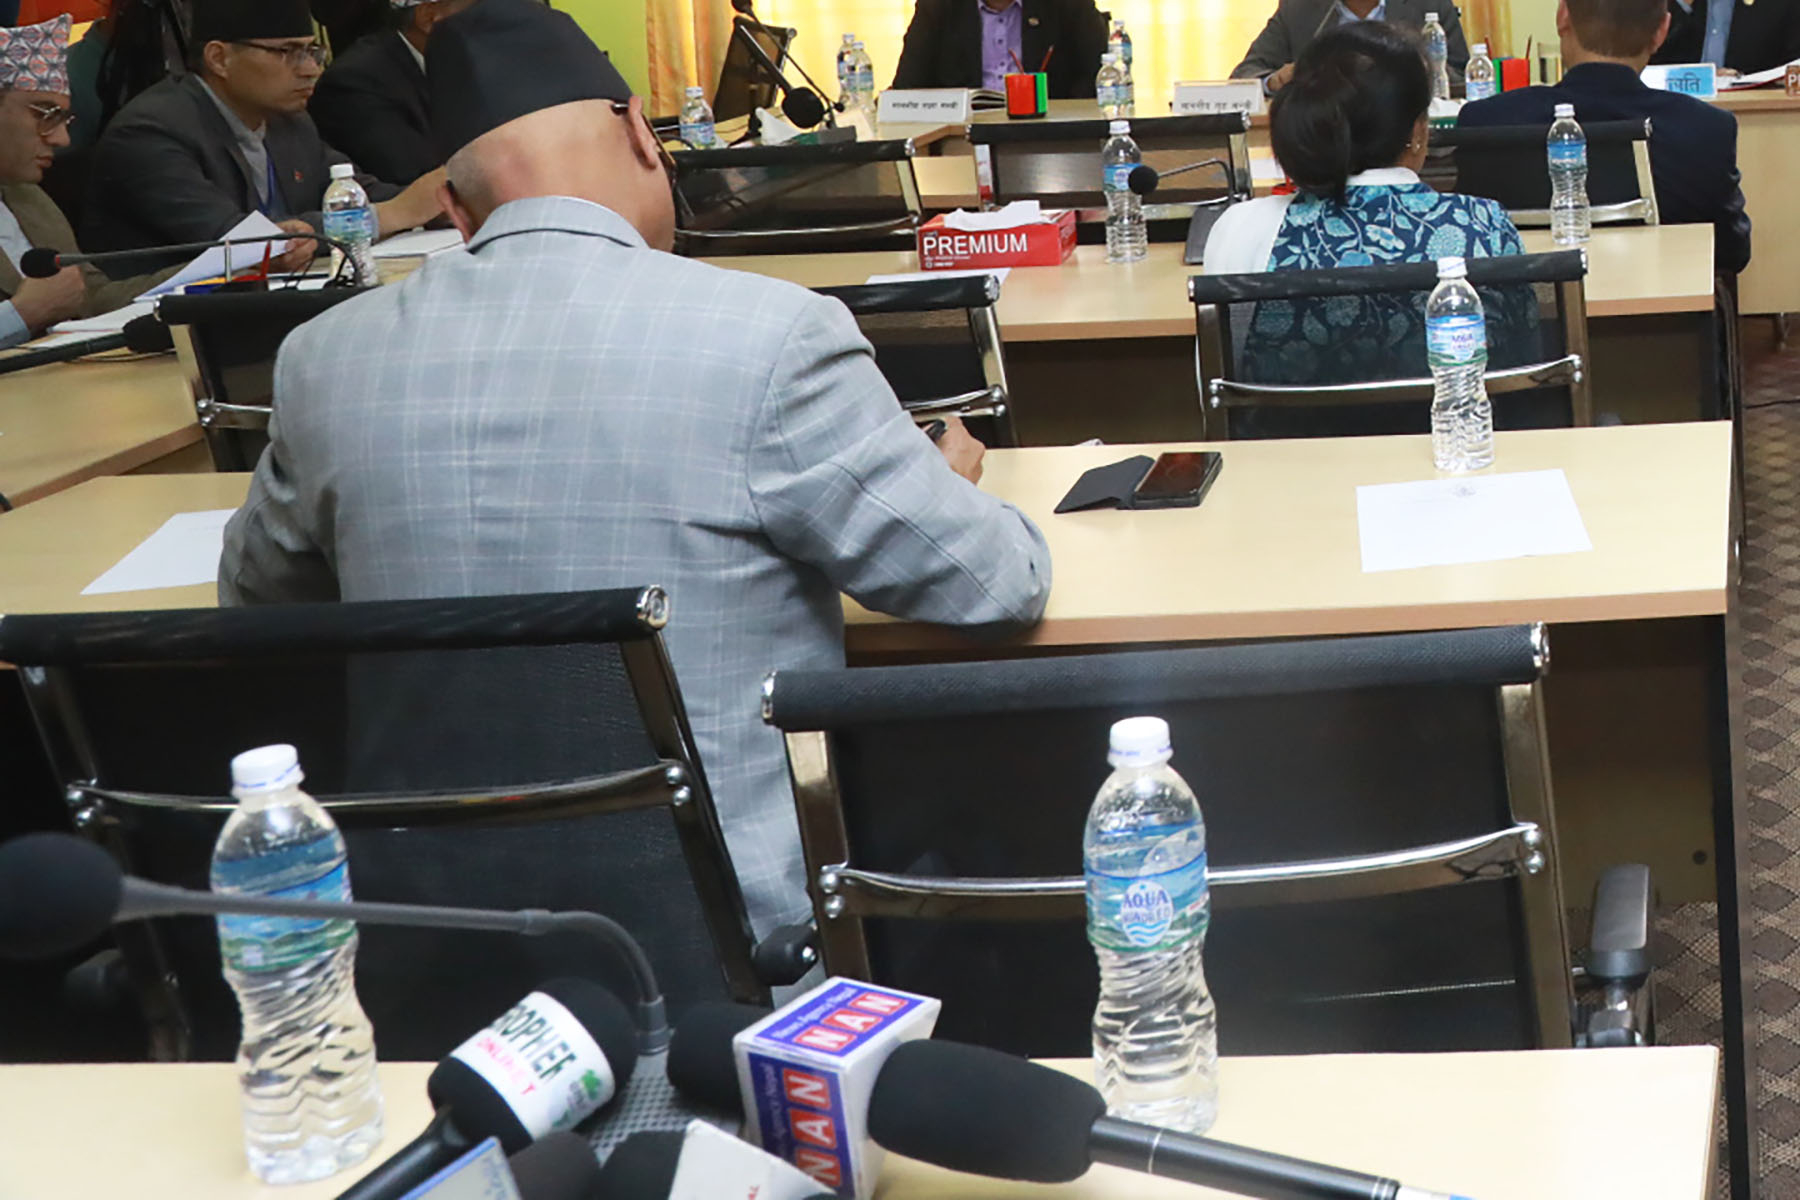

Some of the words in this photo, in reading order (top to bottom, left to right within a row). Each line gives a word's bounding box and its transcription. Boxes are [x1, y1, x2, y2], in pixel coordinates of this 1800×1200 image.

[922, 232, 1029, 256] PREMIUM
[1122, 889, 1169, 909] AQUA
[801, 993, 902, 1050] NAN
[787, 1074, 838, 1182] NAN
